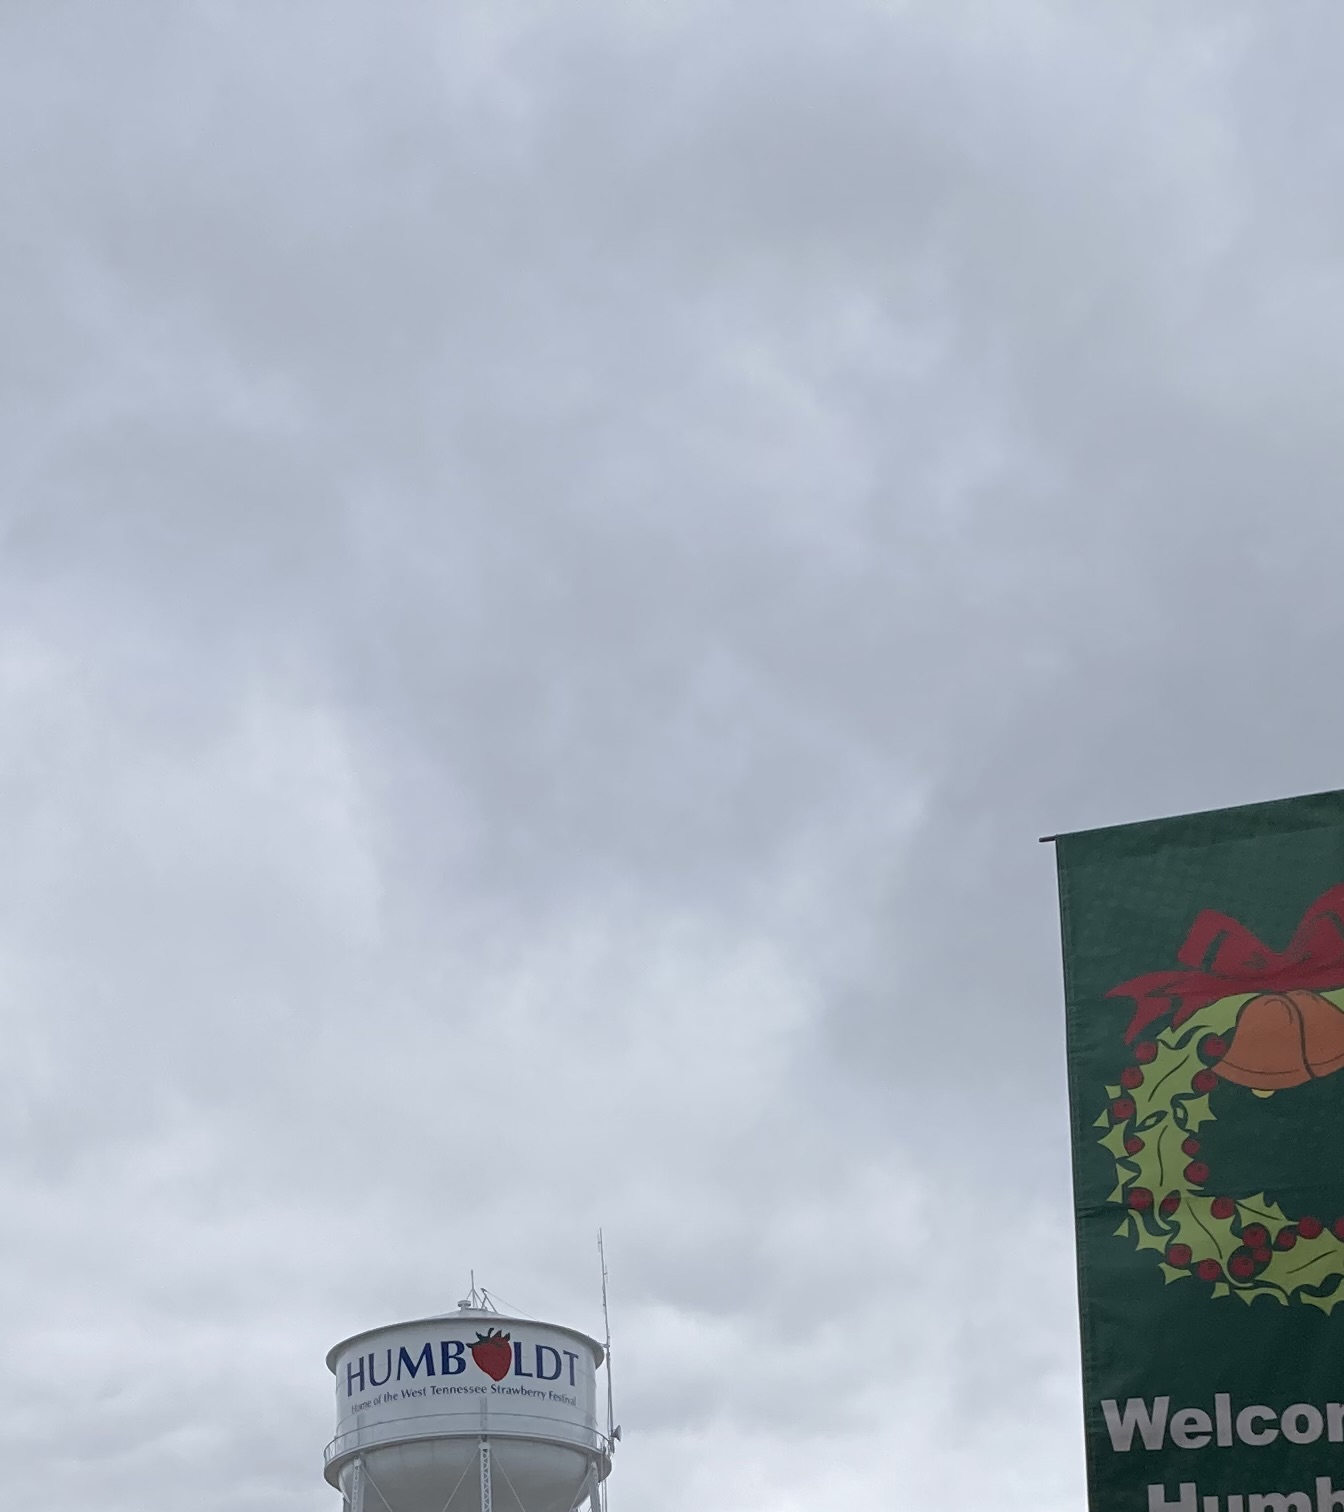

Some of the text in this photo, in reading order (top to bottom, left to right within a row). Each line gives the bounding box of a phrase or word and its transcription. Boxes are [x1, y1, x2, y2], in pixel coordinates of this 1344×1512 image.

[351, 1383, 577, 1414] Home of the West Tennessee Strawberry Festival
